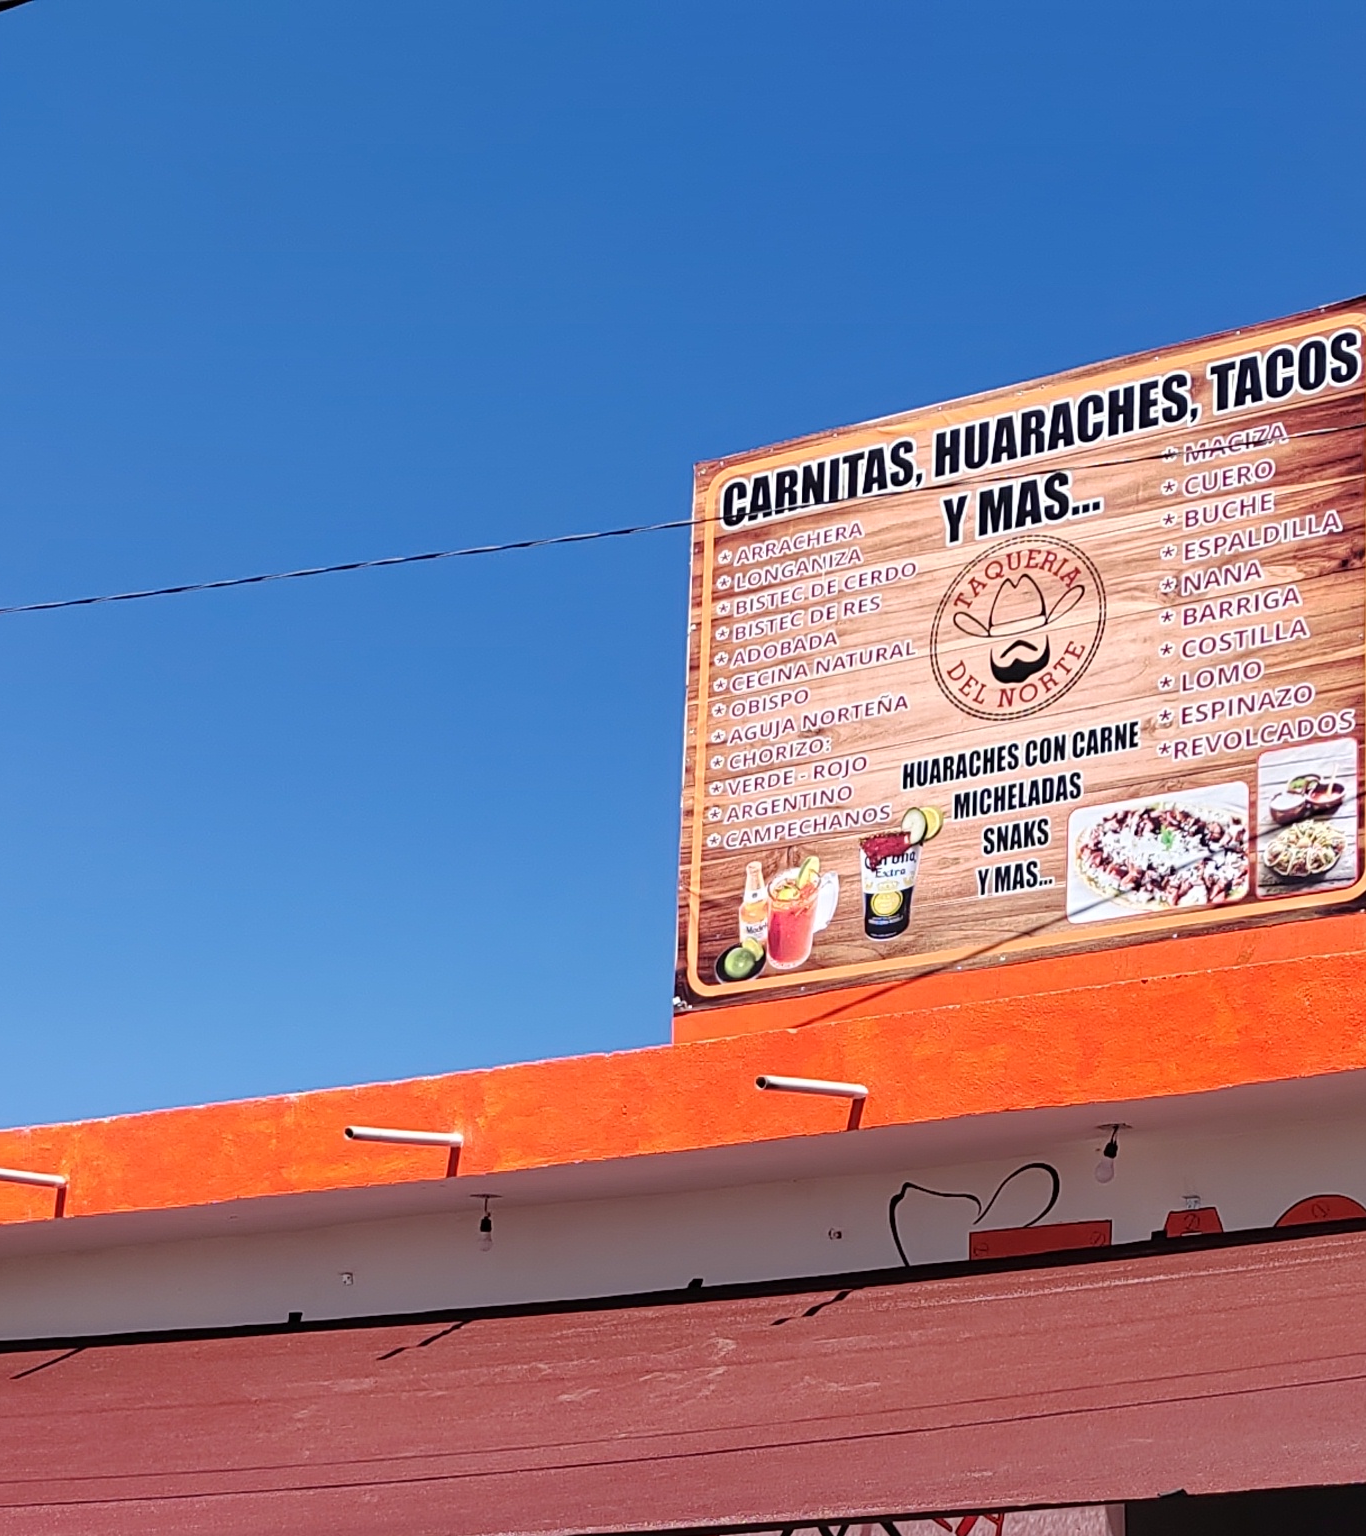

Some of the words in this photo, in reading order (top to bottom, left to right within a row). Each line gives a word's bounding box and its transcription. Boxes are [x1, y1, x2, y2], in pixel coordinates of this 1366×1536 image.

[723, 440, 922, 526] CARNITAS,
[935, 373, 1198, 476] HUARACHES,
[1210, 331, 1358, 410] TACOS
[1185, 424, 1286, 463] MACIZA
[1185, 461, 1273, 495] CUERO
[943, 495, 967, 542] Y
[978, 472, 1101, 536] MAS...
[1185, 492, 1273, 528] BUCHE
[736, 522, 863, 564] ARRACHERA
[1184, 512, 1341, 561] ESPALDILLA
[736, 549, 862, 589] LONGANIZA
[736, 586, 803, 615] BISTEC
[811, 579, 836, 597] DE
[844, 562, 916, 590] CERDO
[953, 549, 1081, 609] TAQUERIA
[1182, 562, 1262, 593] NANA
[735, 612, 803, 641] BISTEC
[810, 606, 836, 624] DE
[843, 596, 881, 617] RES
[1183, 587, 1300, 626] BARRIGA
[733, 631, 837, 667] ADOBADA
[1182, 619, 1307, 658] COSTILLA
[731, 663, 808, 692] CECINA
[816, 641, 916, 673] NATURAL
[947, 660, 987, 704] DEL
[997, 641, 1086, 707] NORTE
[1182, 661, 1262, 692] LOMO
[729, 718, 795, 744] AGUJA
[802, 694, 909, 730] NORTEÑA
[731, 689, 809, 718] OBISPO
[1181, 685, 1313, 725] ESPINAZO
[729, 738, 831, 770] CHORIZO:
[902, 742, 1019, 790] HUARACHES
[1025, 734, 1066, 767] CON
[1072, 721, 1139, 759] CARNE
[1173, 711, 1355, 760] REVOLCADOS
[728, 770, 794, 796] VERDE
[813, 756, 868, 780] ROJO
[953, 772, 1082, 820] MICHELADAS
[727, 785, 853, 823] ARGENTINO
[725, 805, 891, 848] CAMPECHANOS
[983, 818, 1050, 855] SNAKS
[875, 868, 906, 878] Extra
[977, 868, 989, 896] Y
[994, 860, 1053, 894] MAS...
